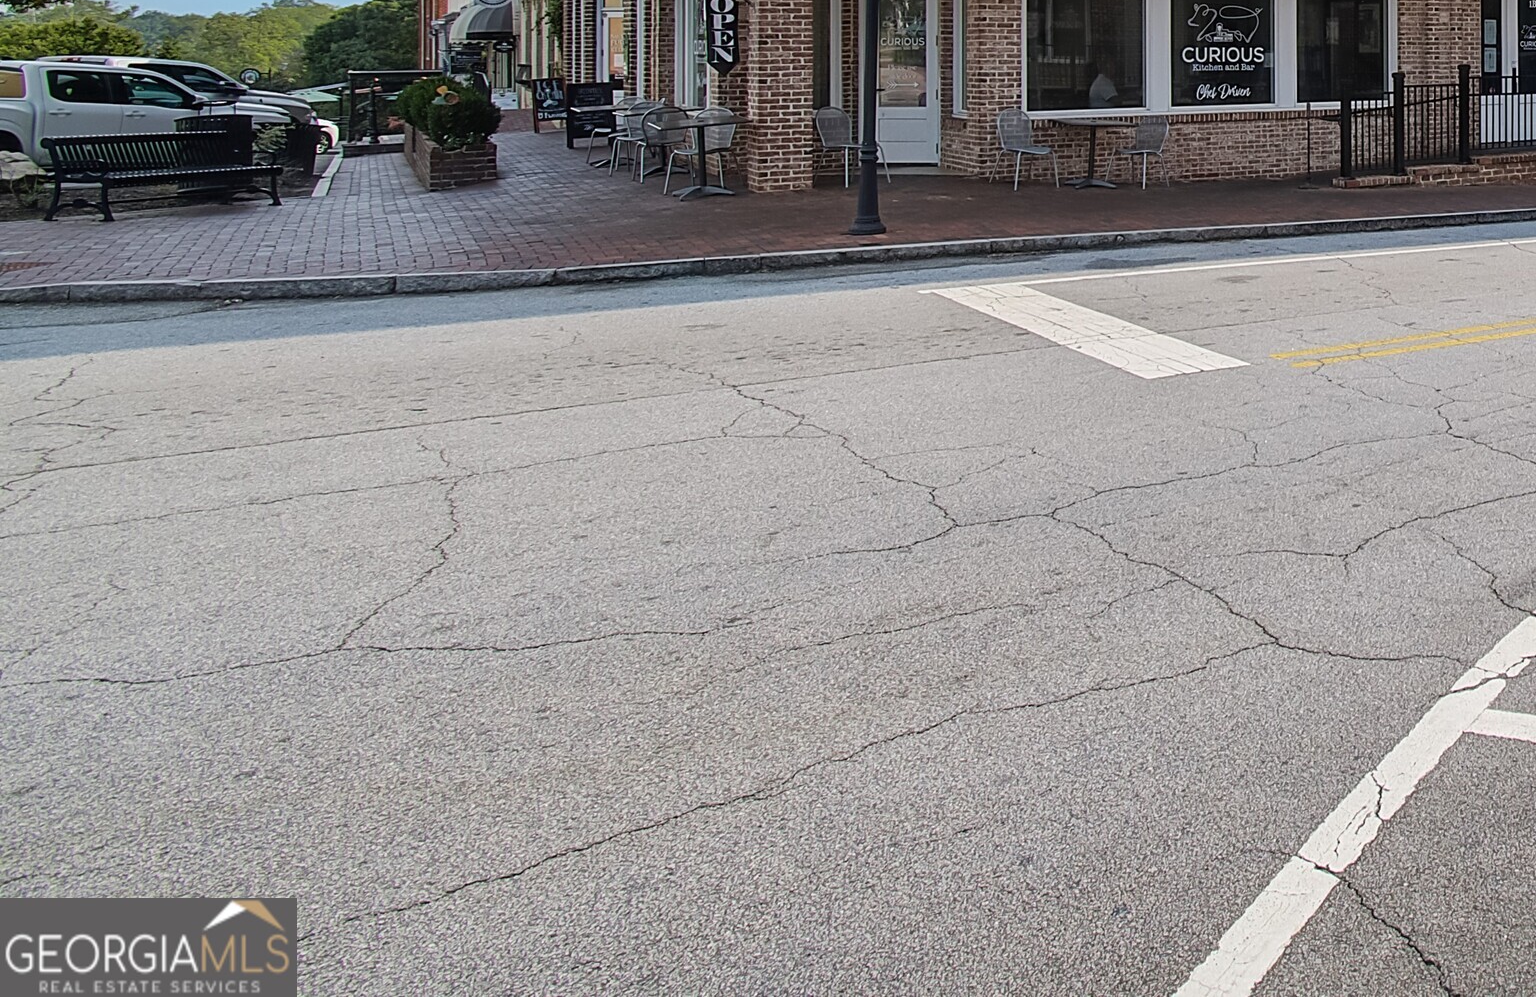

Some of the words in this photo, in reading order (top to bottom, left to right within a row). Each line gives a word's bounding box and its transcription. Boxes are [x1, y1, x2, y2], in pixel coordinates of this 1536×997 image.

[880, 37, 926, 46] CURIOUS
[1181, 46, 1265, 63] CURIOUS
[1192, 63, 1223, 72] Kitchen
[1224, 63, 1240, 71] and
[1241, 63, 1256, 71] Bar
[1196, 83, 1217, 101] Chef
[1217, 83, 1252, 99] Driven
